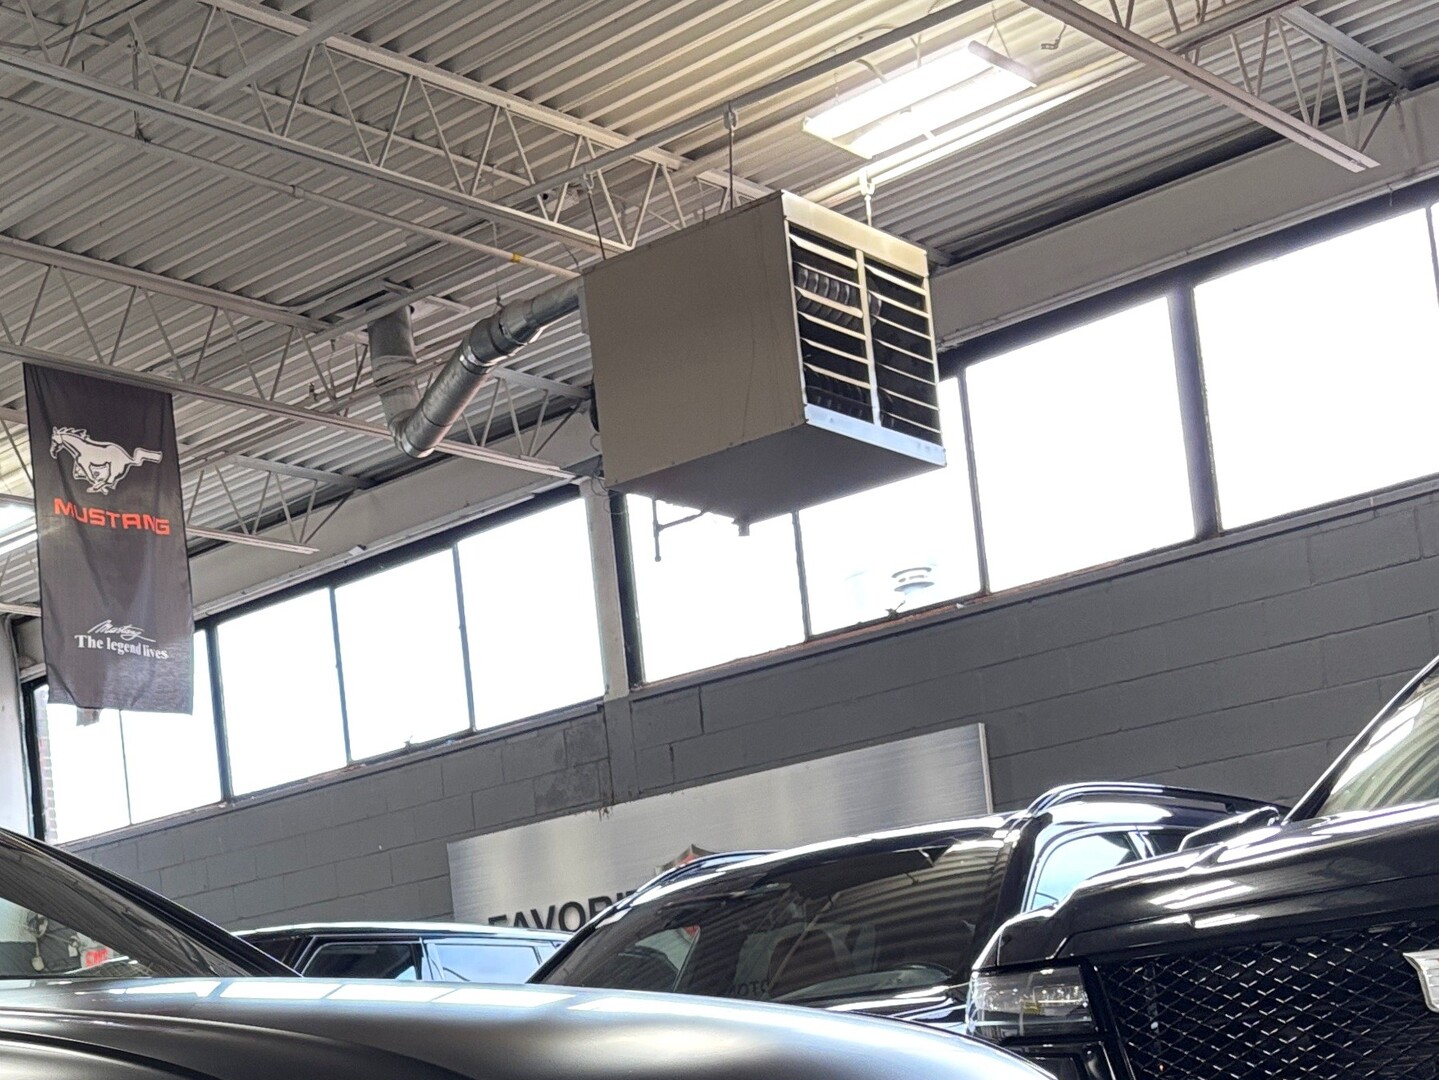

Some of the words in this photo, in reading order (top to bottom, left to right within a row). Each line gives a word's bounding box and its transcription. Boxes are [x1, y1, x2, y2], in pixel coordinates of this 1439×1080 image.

[54, 498, 170, 535] MUSTANG
[75, 635, 104, 649] The
[106, 637, 142, 656] legend
[143, 644, 169, 660] lives
[488, 889, 638, 932] AVOR
